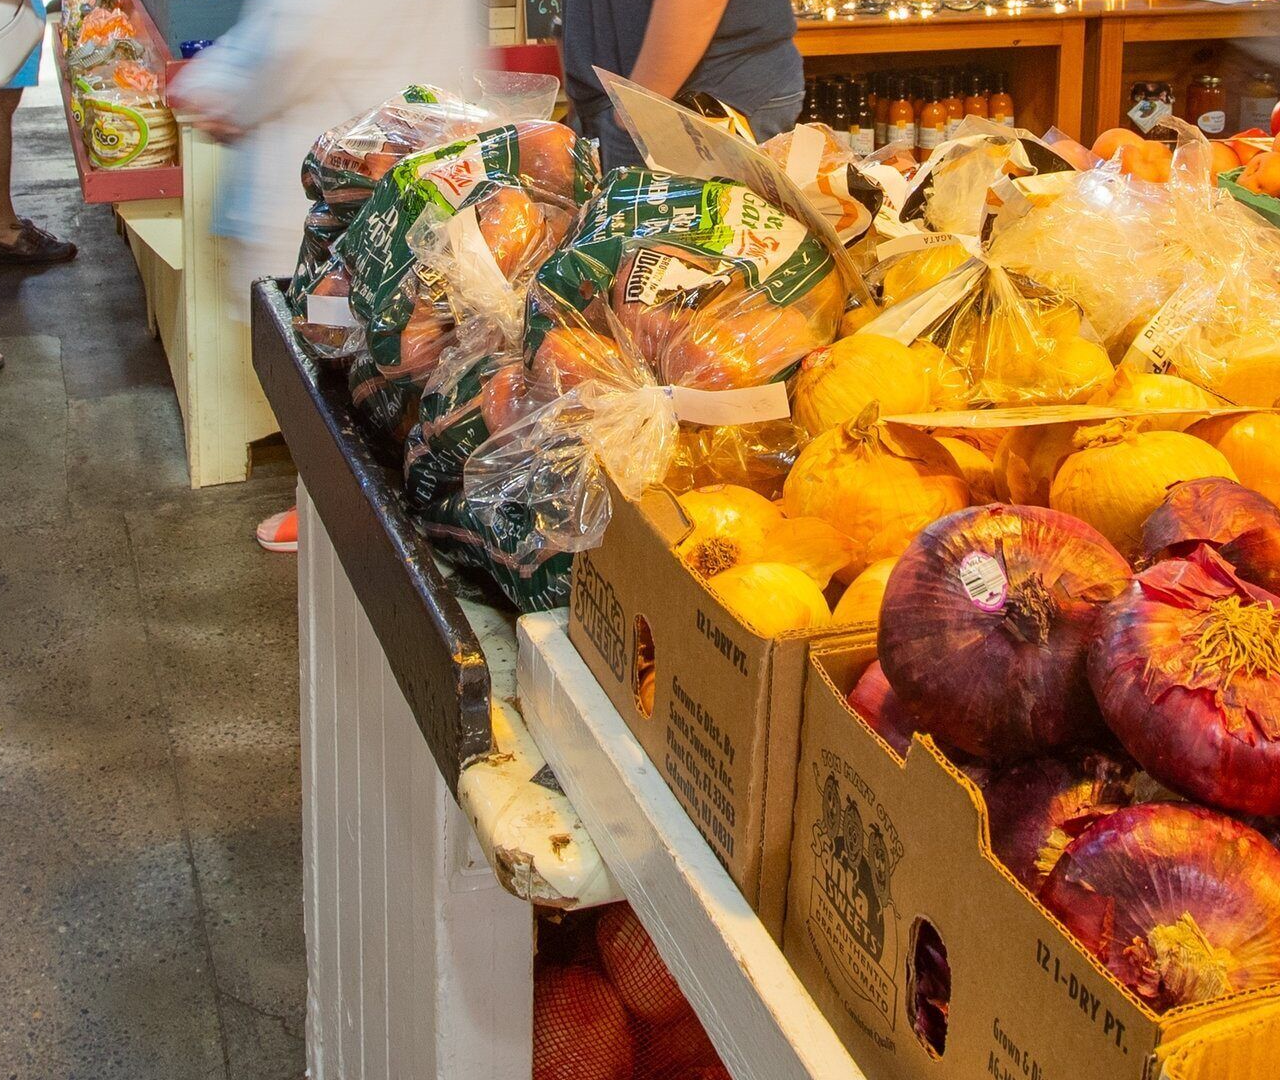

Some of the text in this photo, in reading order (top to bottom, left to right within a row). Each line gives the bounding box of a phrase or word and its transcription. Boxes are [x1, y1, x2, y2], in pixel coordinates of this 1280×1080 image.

[626, 250, 658, 302] IDAHO
[696, 608, 749, 678] 12 1-DRY PT.
[669, 700, 735, 796] Santa Sweets, Inc.
[672, 675, 736, 765] Grown & Dist. By
[665, 752, 735, 858] Cedarville, NJ 08311
[666, 725, 736, 828] Plant City, FL 33563
[815, 909, 889, 1014] GRAPE TOMATO
[817, 893, 889, 997] THE AUTHENTIC
[1036, 938, 1128, 1055] 12 1-DRY PT.
[993, 1017, 1021, 1067] Grown
[1022, 1050, 1030, 1076] &
